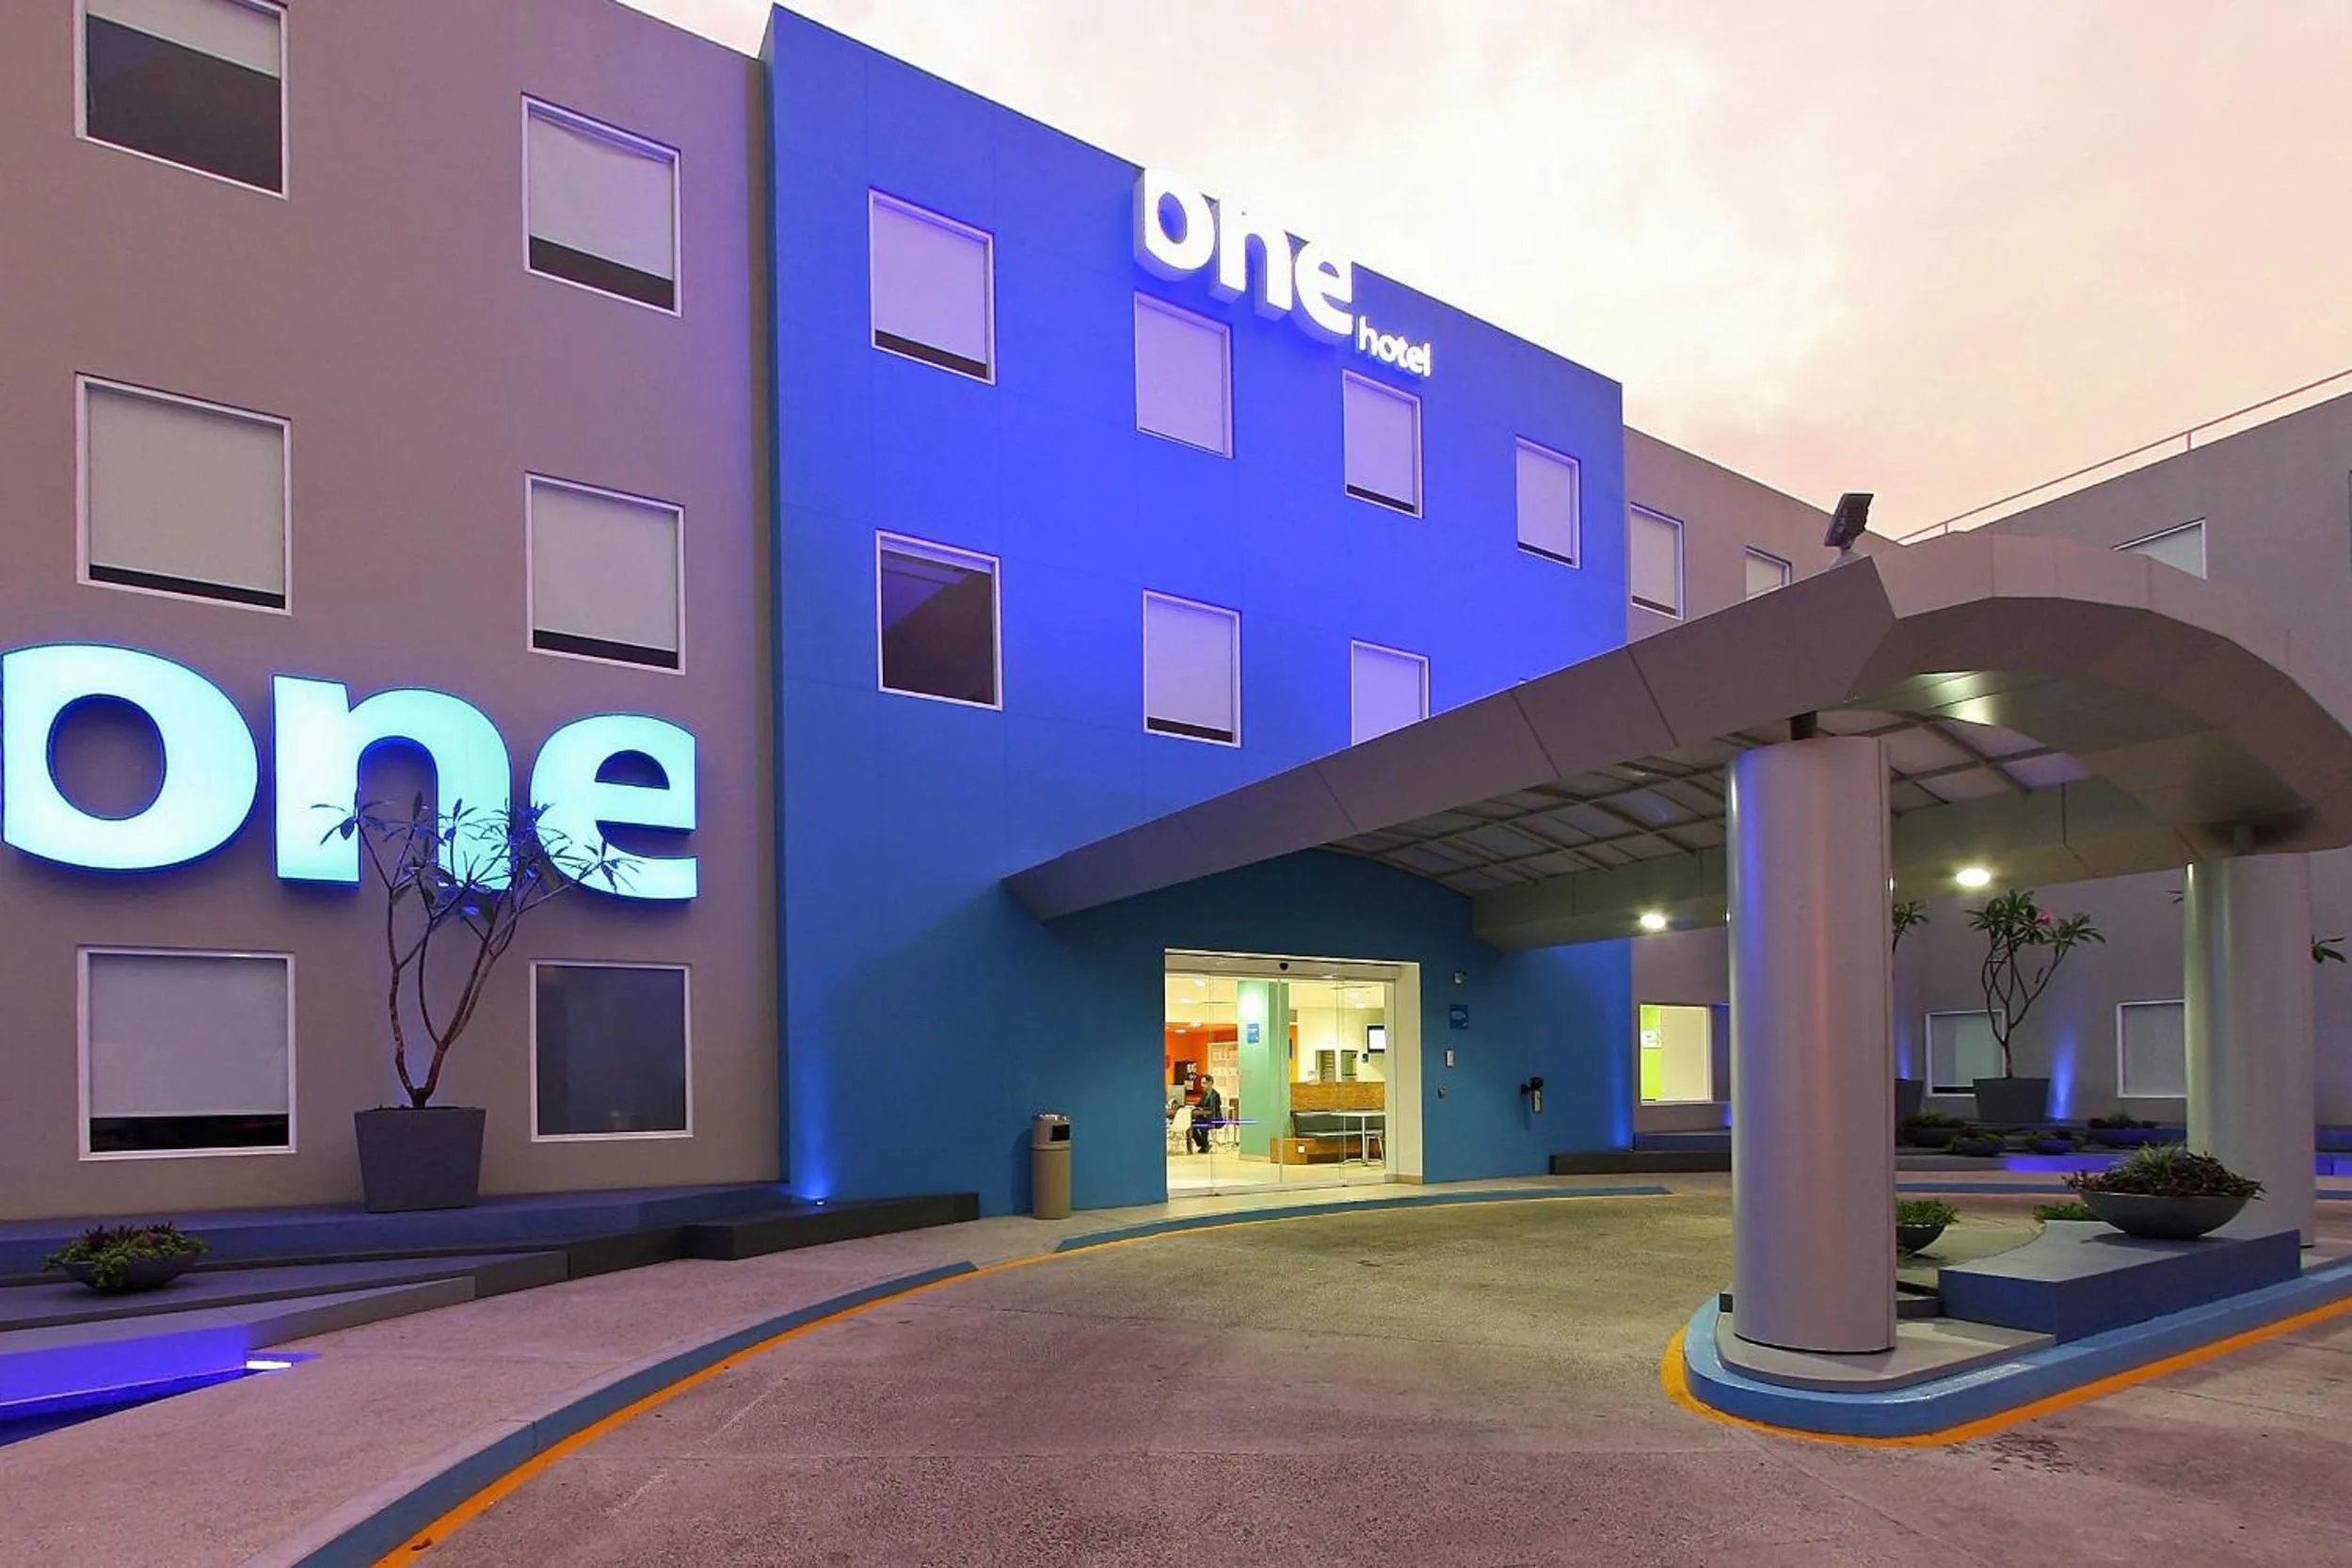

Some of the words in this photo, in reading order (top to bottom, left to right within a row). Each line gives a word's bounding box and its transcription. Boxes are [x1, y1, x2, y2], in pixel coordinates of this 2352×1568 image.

[1140, 167, 1352, 336] one
[1358, 315, 1432, 376] hotel
[1, 642, 698, 900] one
